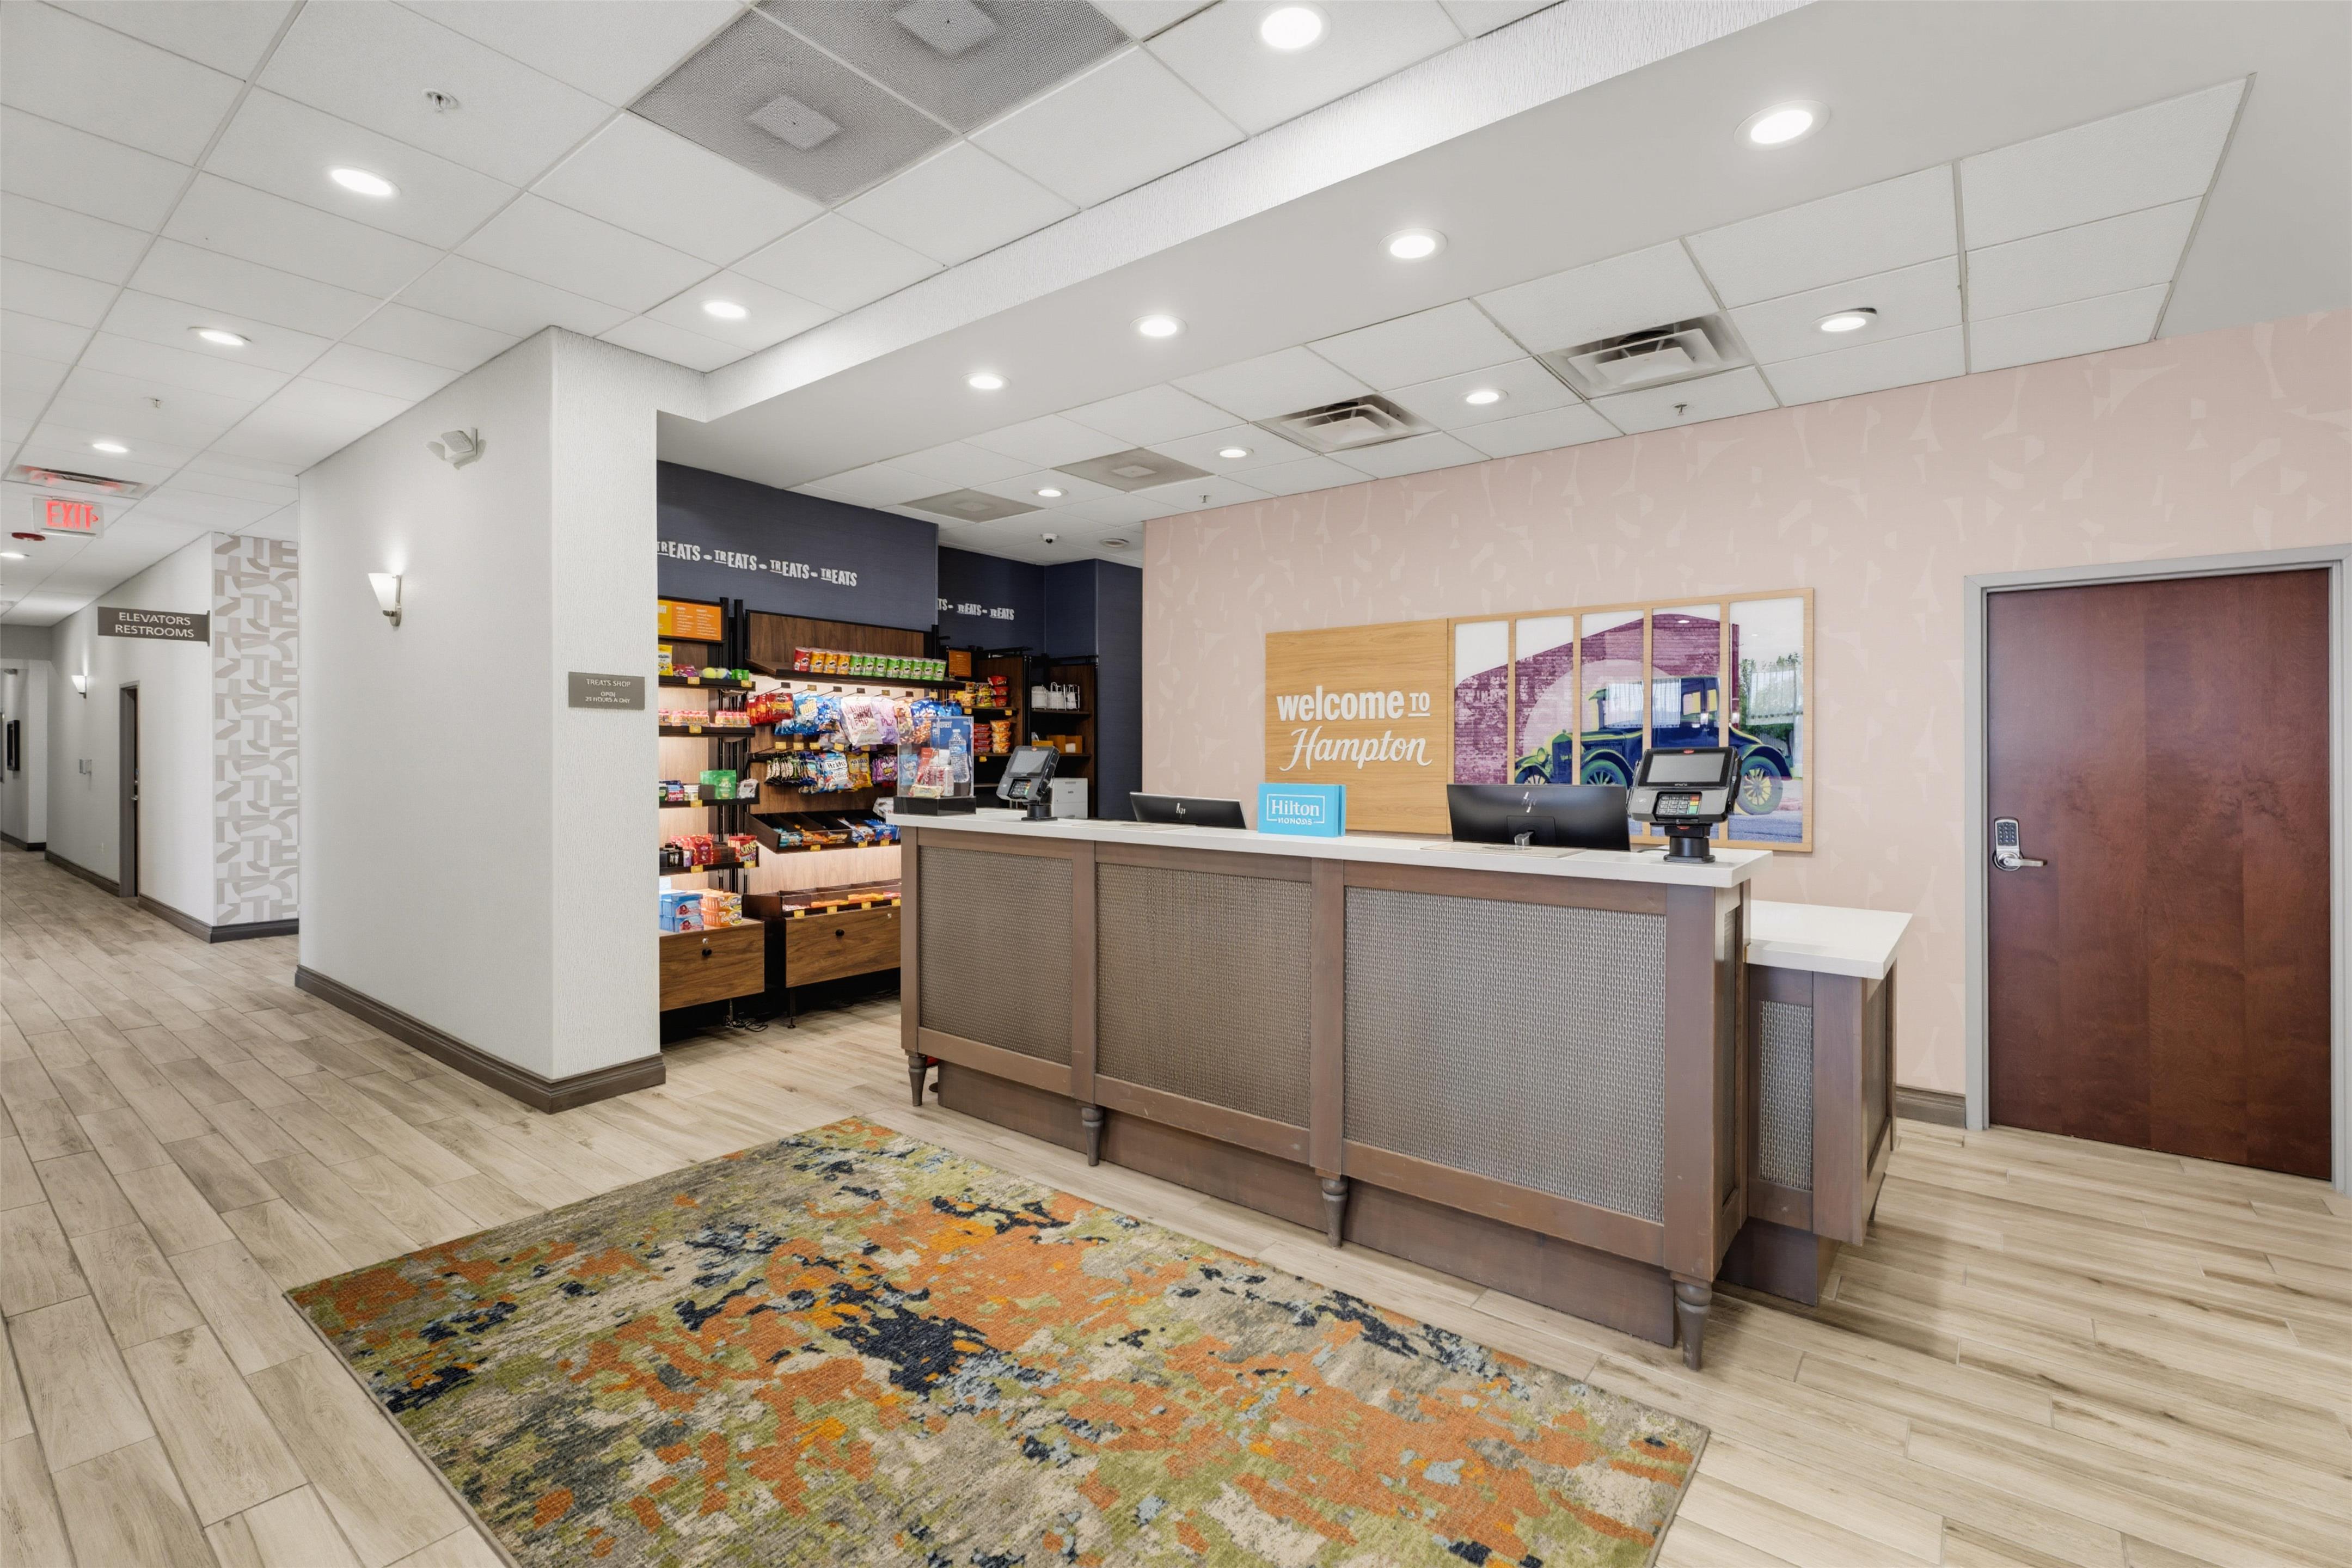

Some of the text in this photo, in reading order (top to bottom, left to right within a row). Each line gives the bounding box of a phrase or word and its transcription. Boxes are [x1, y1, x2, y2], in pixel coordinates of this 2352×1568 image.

[46, 500, 94, 530] EXIT
[714, 549, 757, 571] TREATS
[769, 560, 810, 579] TREATS
[820, 567, 857, 587] TREATS
[119, 611, 191, 626] ELEVATORS
[115, 624, 194, 638] RESTROOMS
[586, 678, 611, 687] TREATS
[1276, 685, 1431, 721] welcome TO
[1279, 726, 1433, 771] Hampton
[1271, 799, 1320, 817] Hilton
